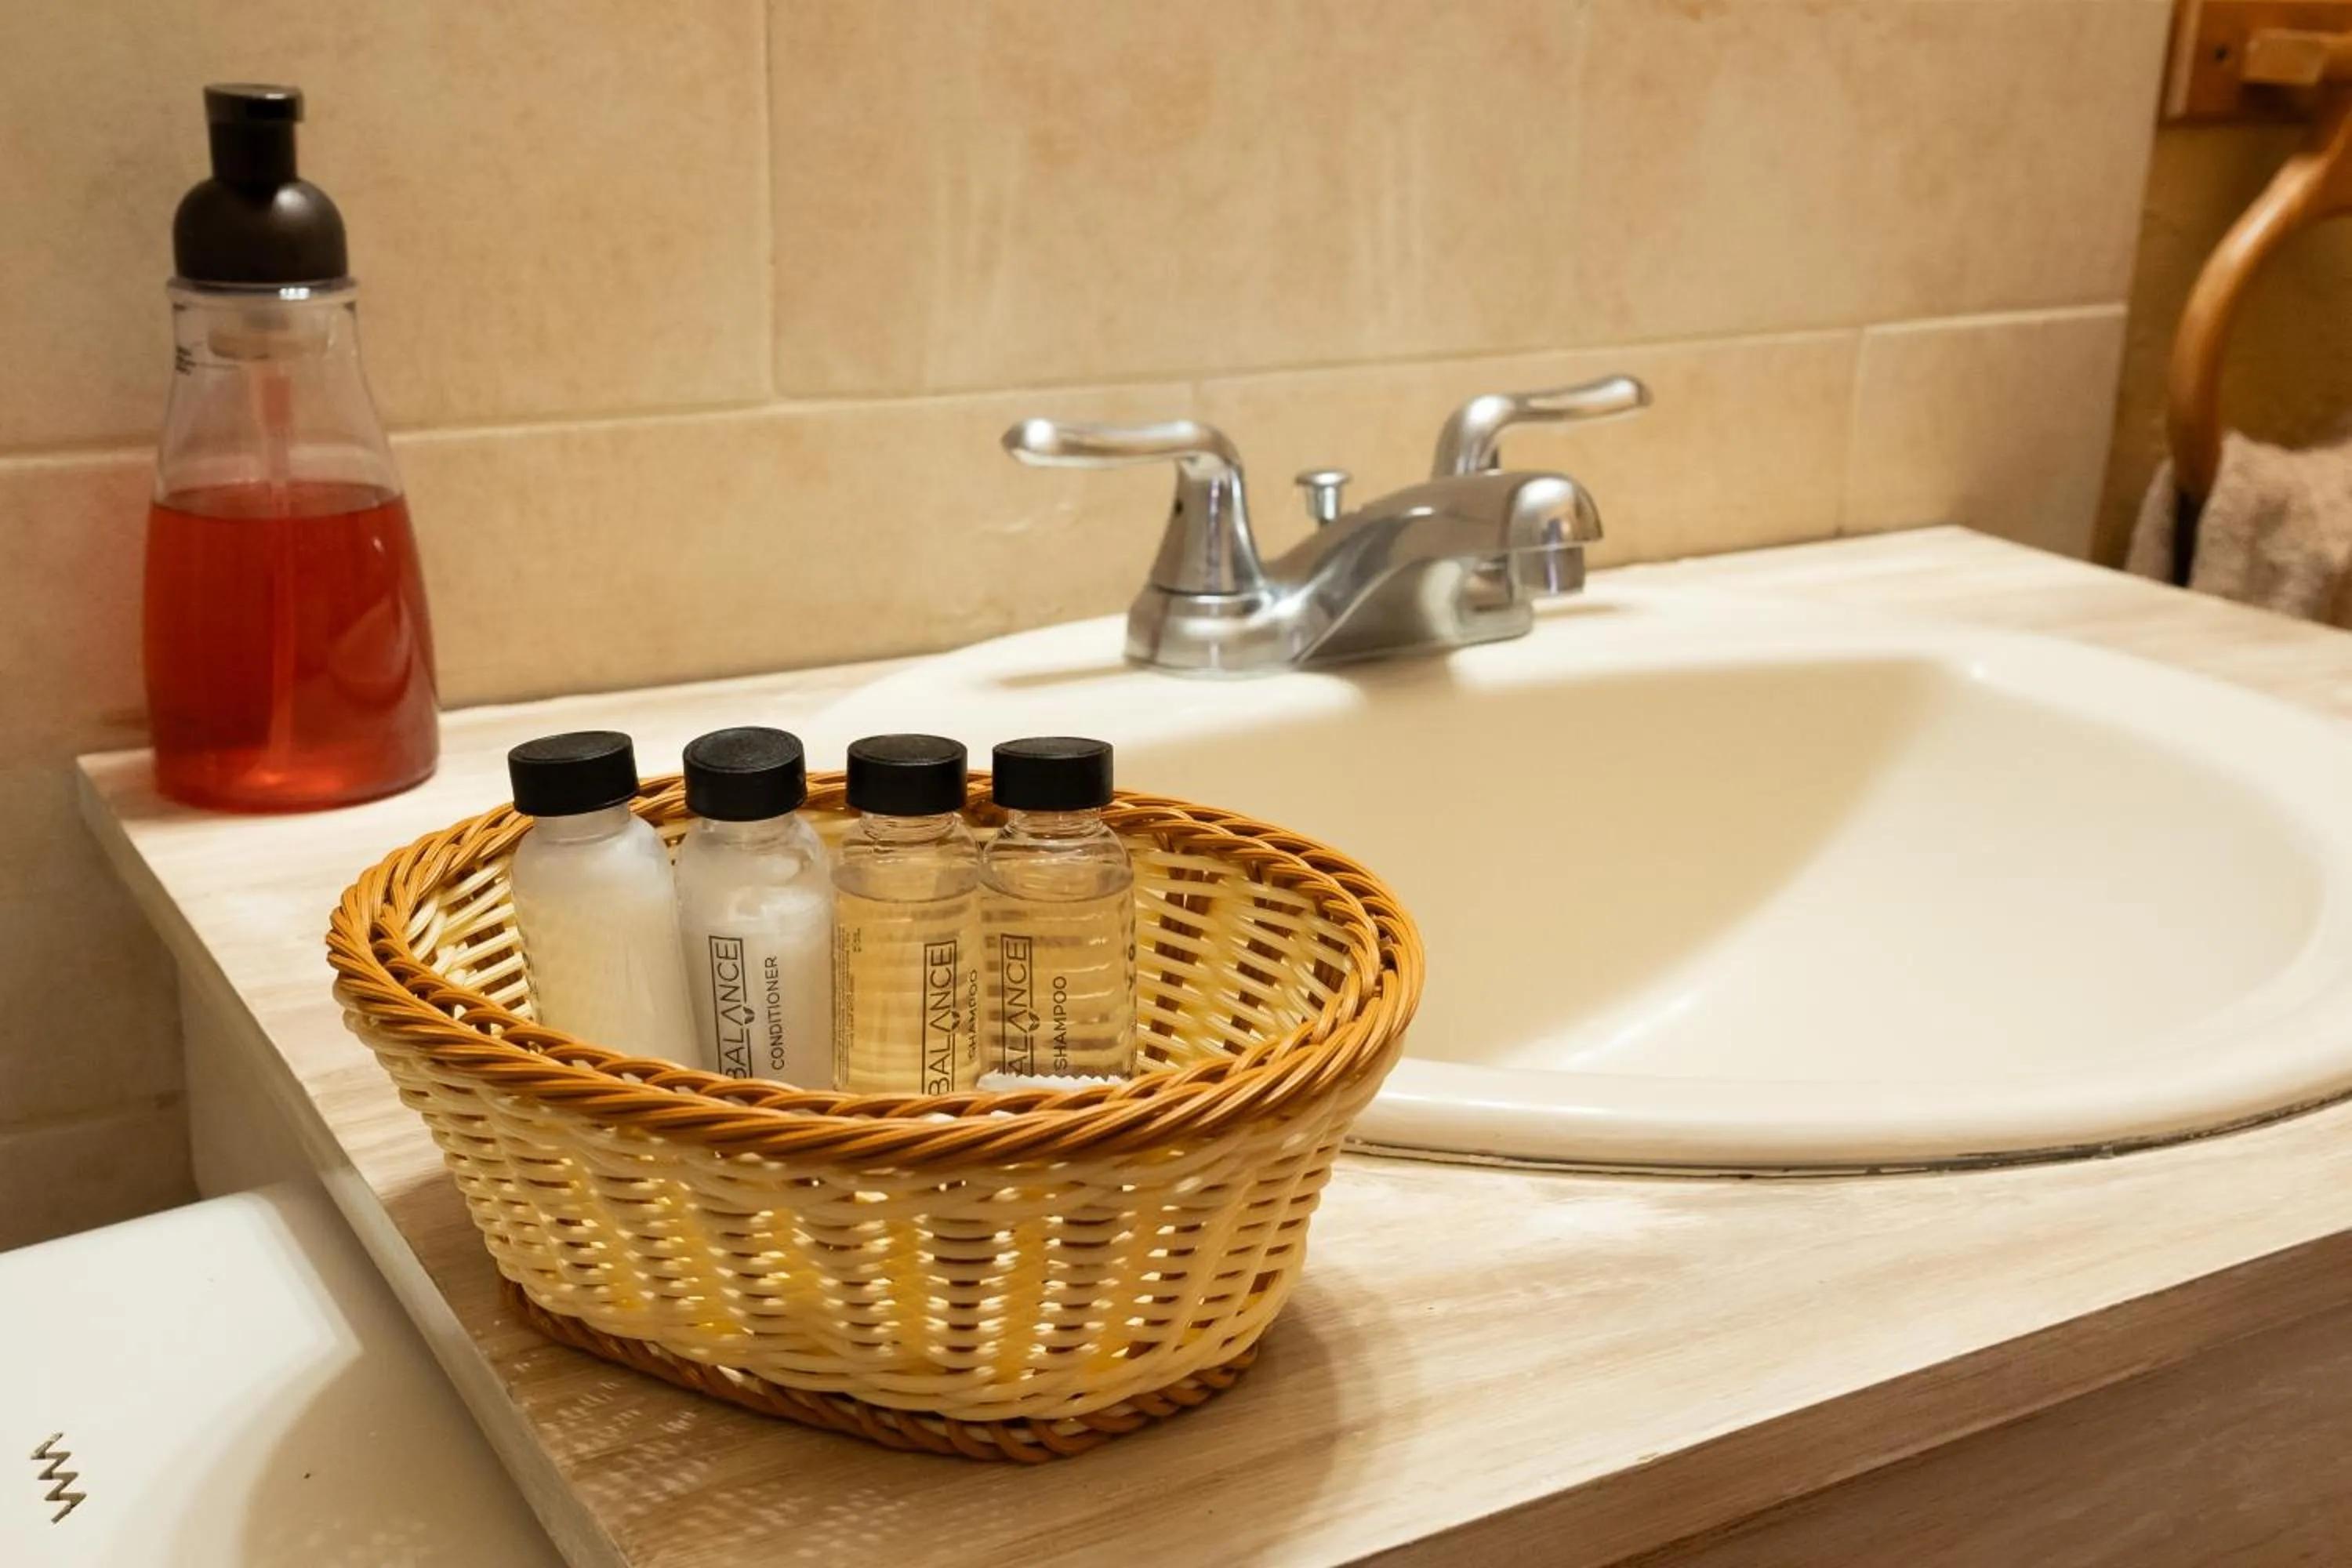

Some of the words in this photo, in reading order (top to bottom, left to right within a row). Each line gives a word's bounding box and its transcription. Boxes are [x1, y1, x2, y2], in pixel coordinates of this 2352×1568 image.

[715, 941, 747, 1080] BALANCE
[764, 956, 785, 1070] CONDITIONER
[927, 946, 953, 1096] BALANCE
[967, 968, 978, 1059] SHAMPOO
[1006, 940, 1029, 1076] ALANCE
[1053, 976, 1068, 1071] SHAMPOO
